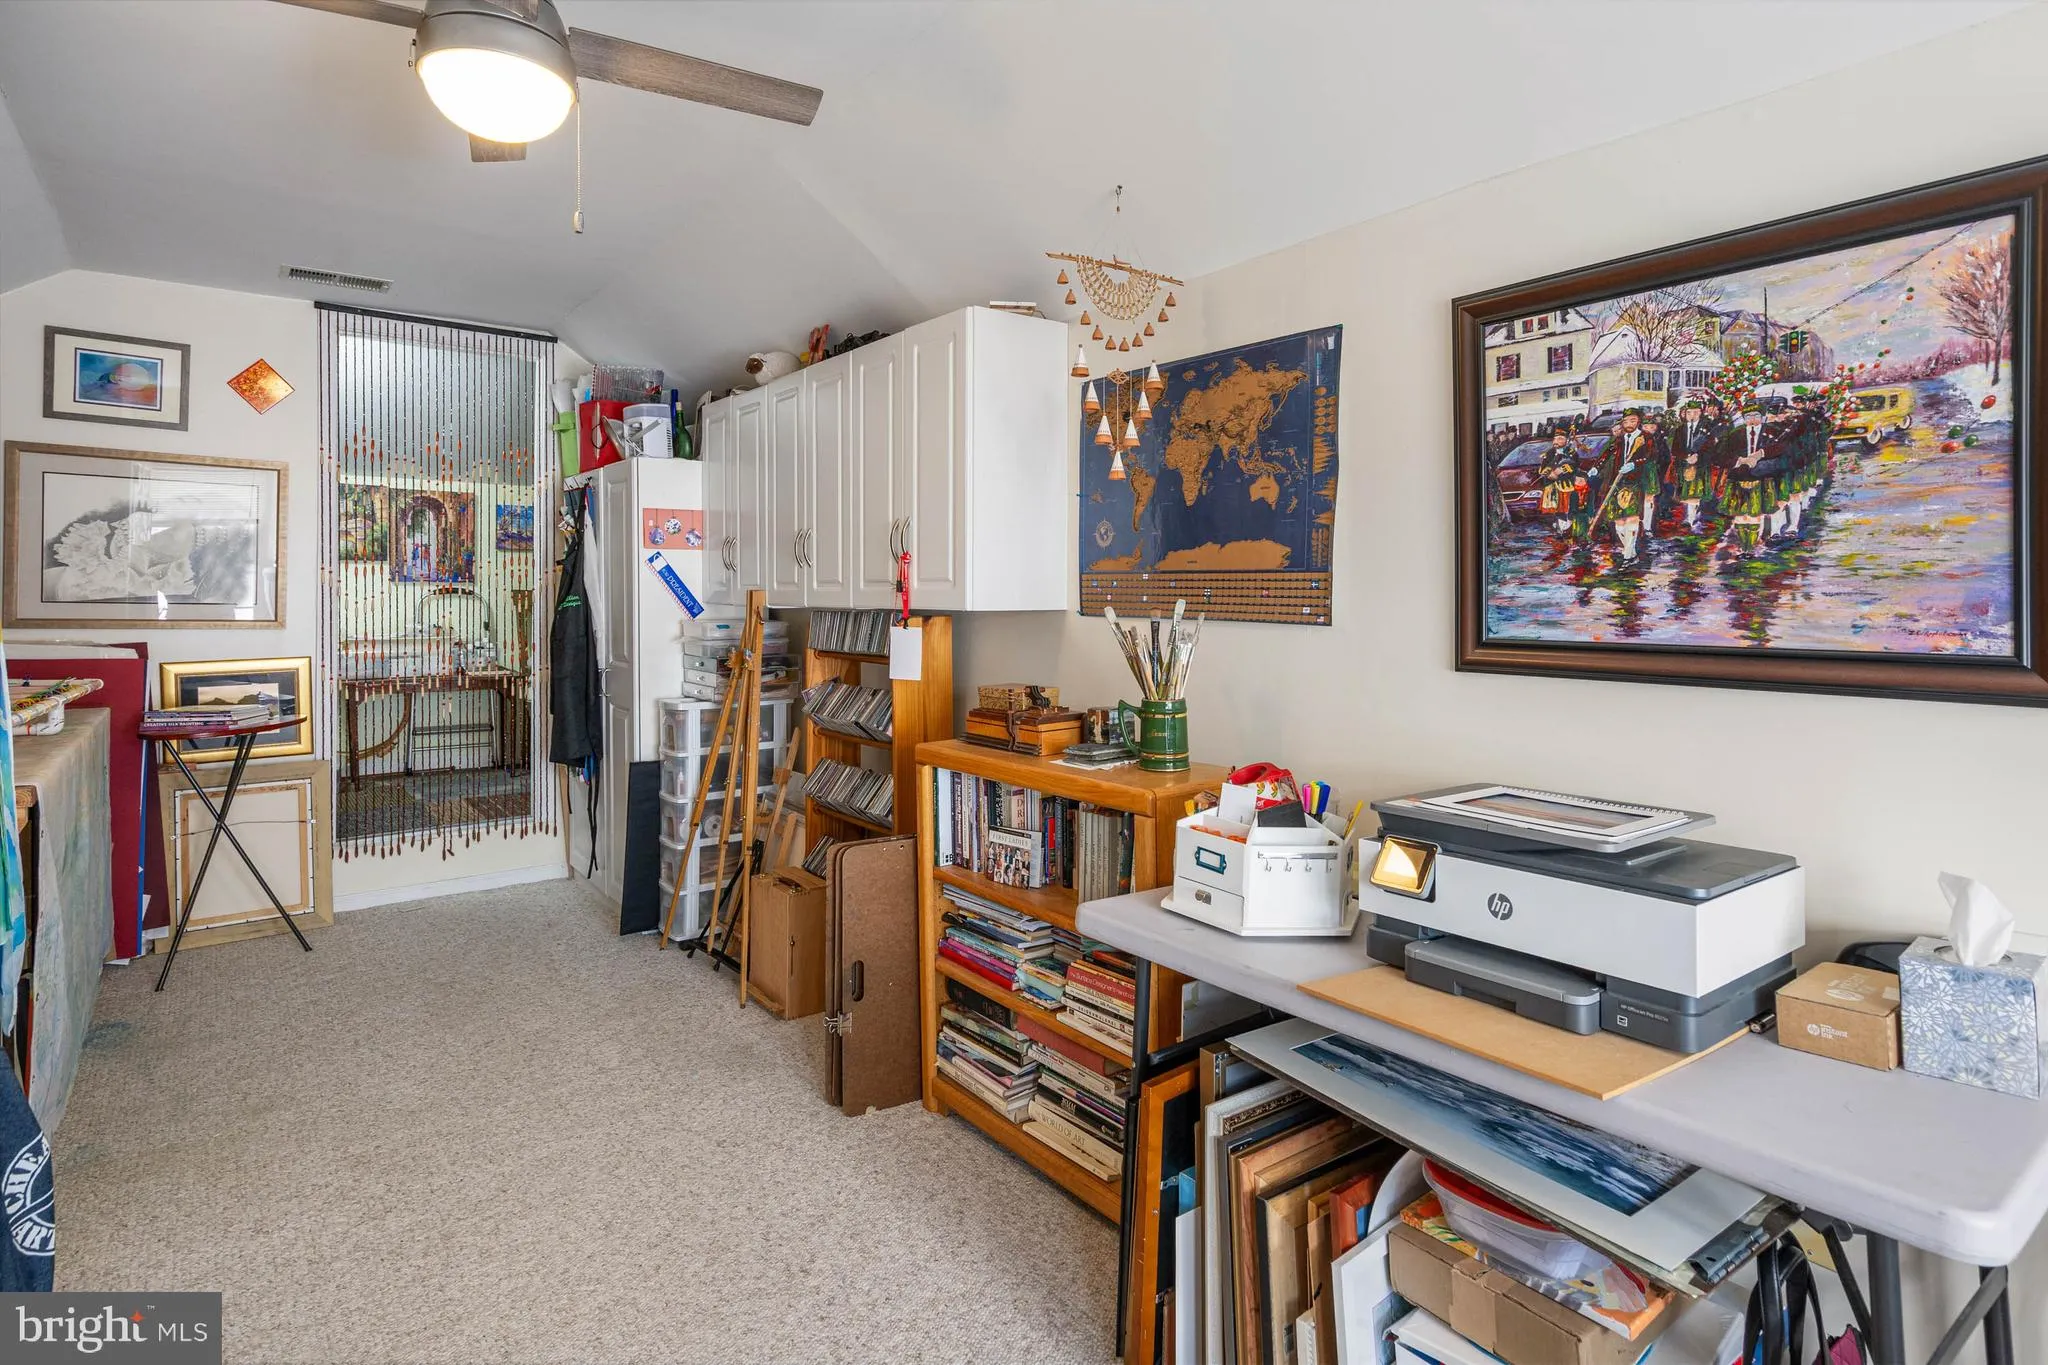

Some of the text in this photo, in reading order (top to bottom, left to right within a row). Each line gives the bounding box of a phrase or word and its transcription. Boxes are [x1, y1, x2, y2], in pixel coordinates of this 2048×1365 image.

[667, 575, 694, 608] PRESIDENT
[1490, 892, 1511, 920] hp
[1040, 1111, 1086, 1146] WORLD OF ART
